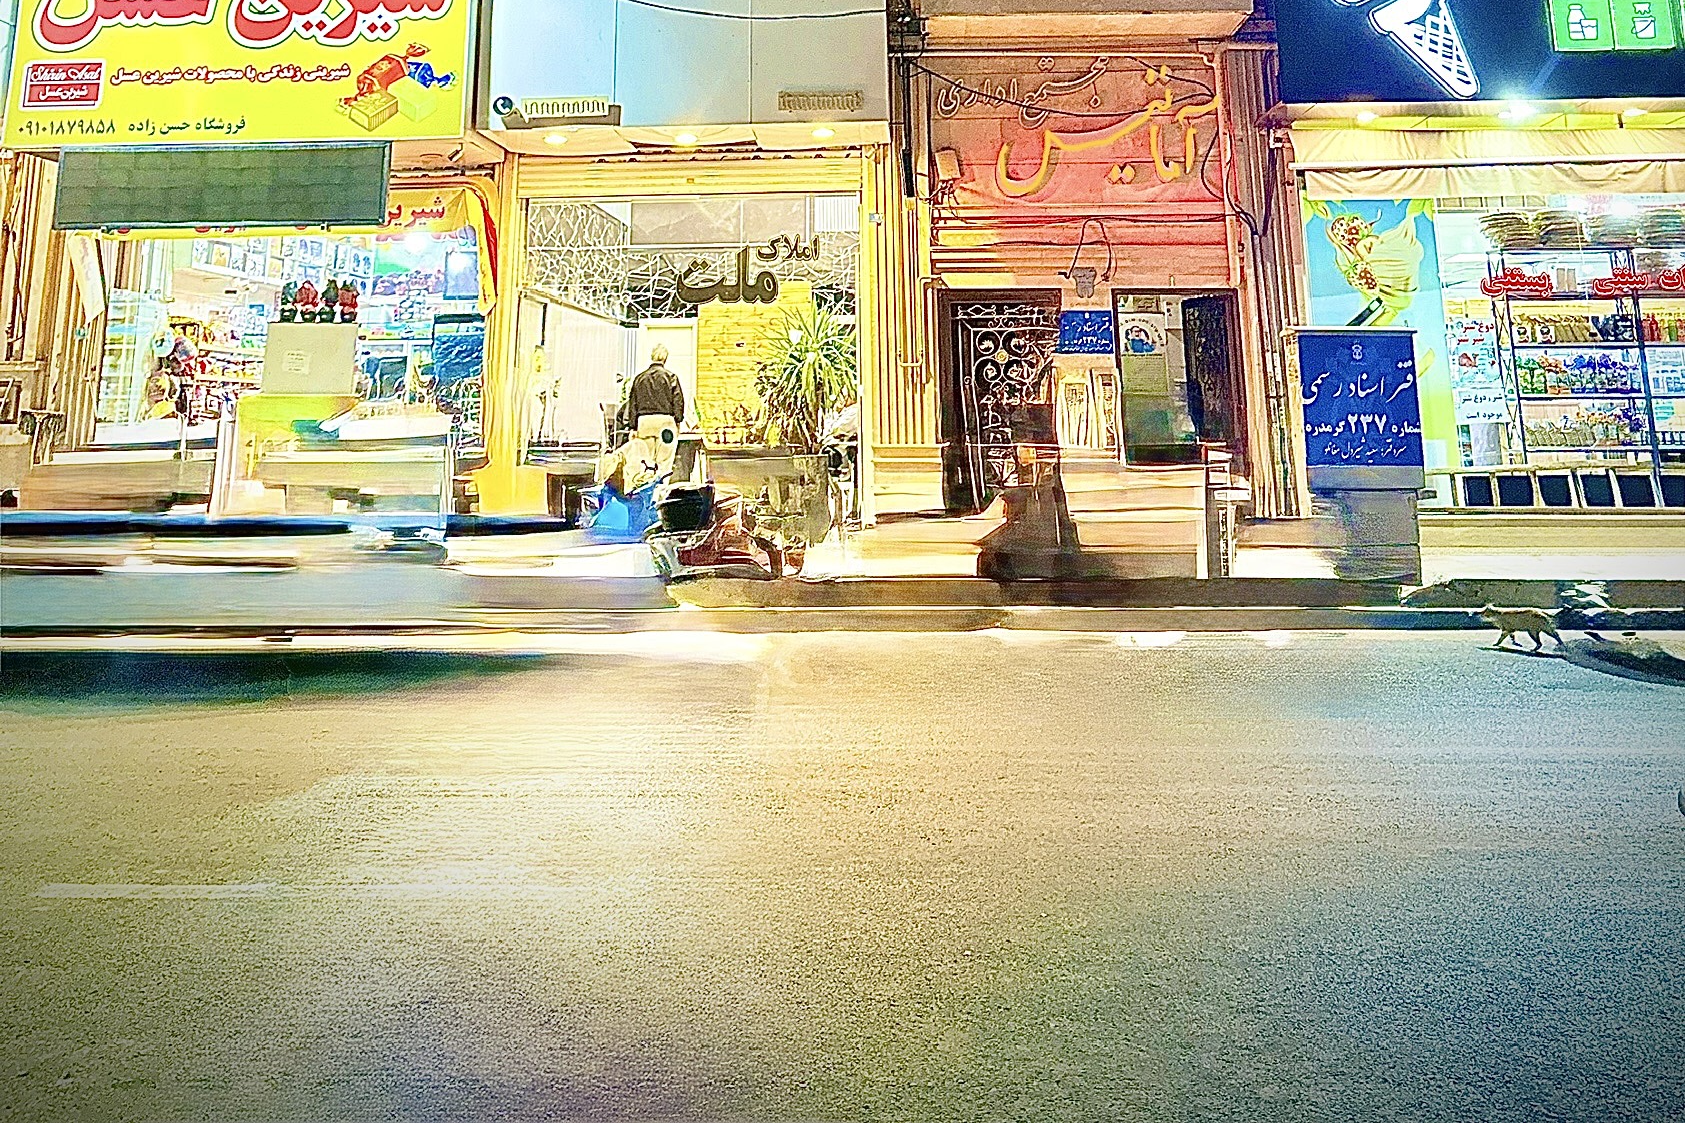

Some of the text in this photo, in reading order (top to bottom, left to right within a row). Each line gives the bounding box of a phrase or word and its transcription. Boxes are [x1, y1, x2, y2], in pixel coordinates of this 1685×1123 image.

[110, 63, 351, 86] شیرینی زندگی با محصولات شیرین عسل
[938, 78, 1018, 118] اداری
[18, 117, 116, 136] ۰۹۱۰۱۸۷۹۸۵۸
[127, 115, 246, 136] فروشگاه حسن زاده
[756, 233, 820, 262] املاک
[675, 246, 779, 304] ملت
[1481, 267, 1553, 298] بستنی
[1593, 267, 1648, 296] سنتی
[1301, 360, 1414, 405] فتر اسناد رسمی
[1305, 420, 1346, 437] گرمدره
[1347, 413, 1387, 434] ۲۳۷
